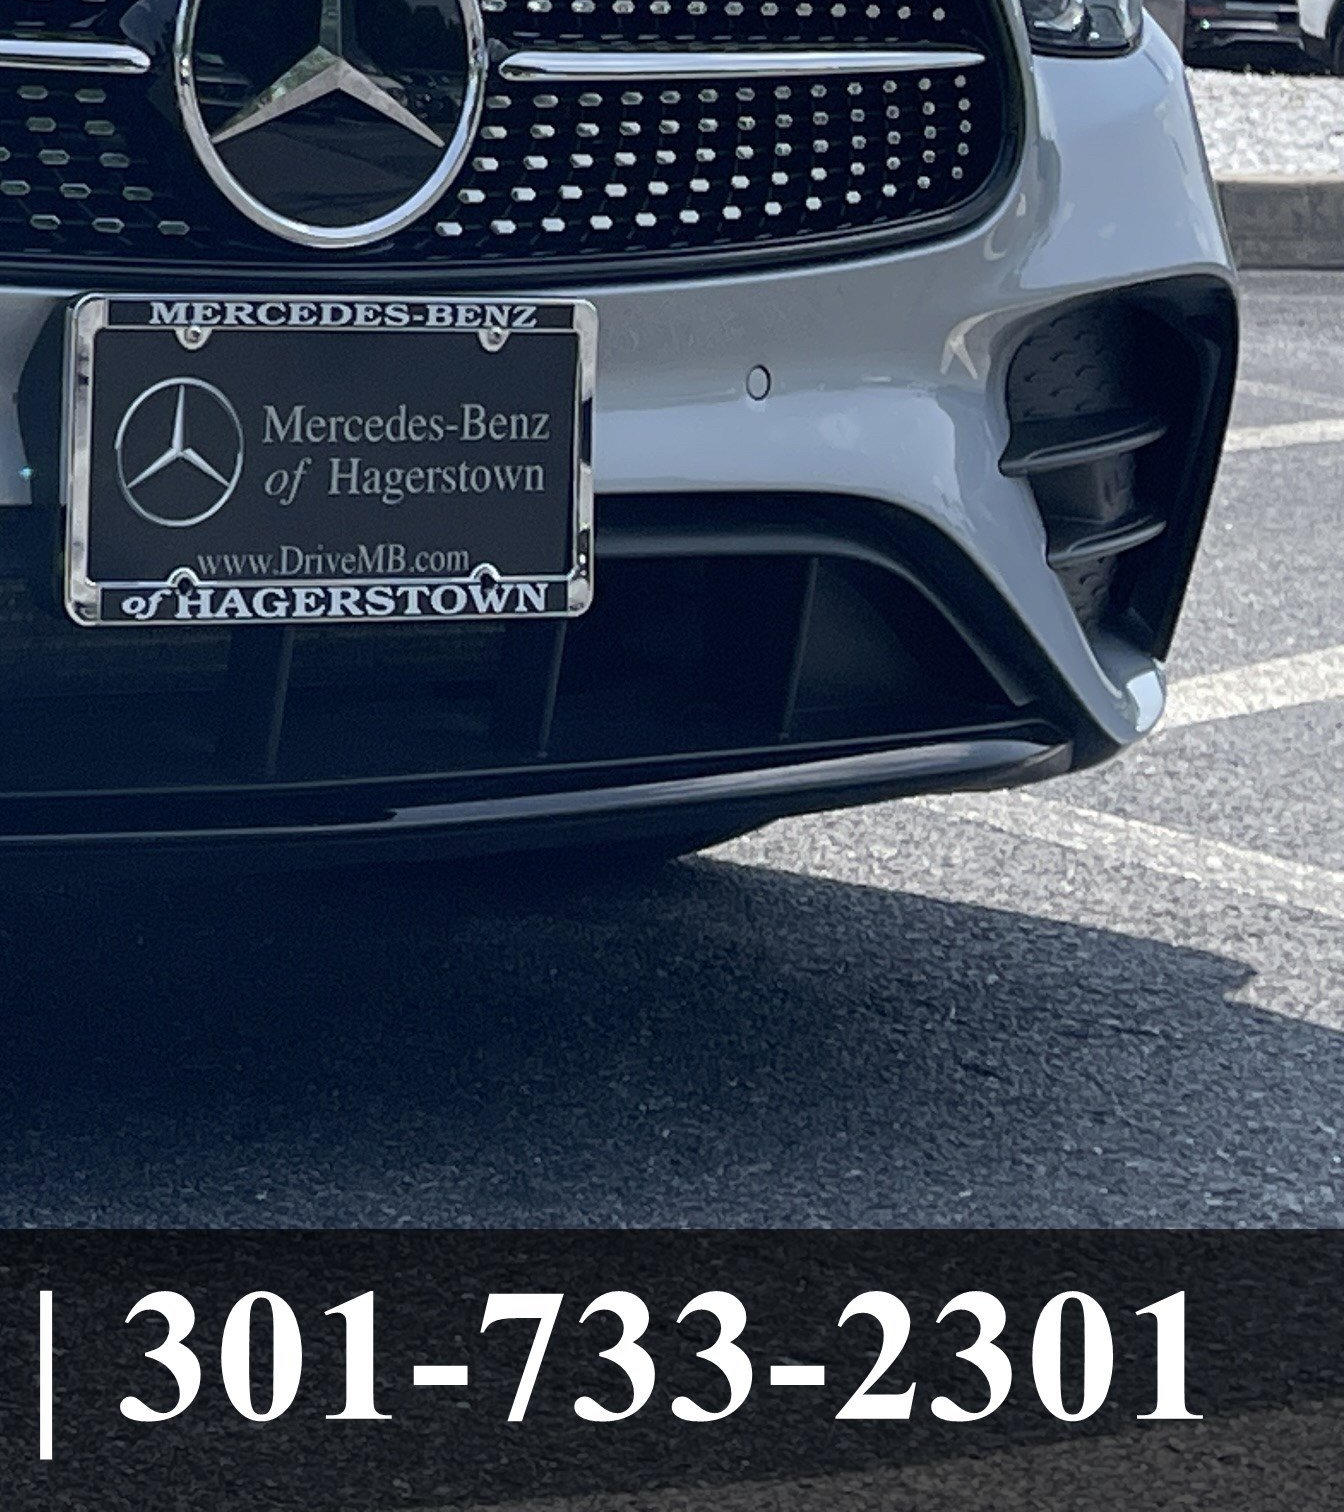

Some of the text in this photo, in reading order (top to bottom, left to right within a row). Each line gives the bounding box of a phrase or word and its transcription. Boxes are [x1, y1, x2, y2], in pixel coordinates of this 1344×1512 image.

[148, 302, 538, 328] MERCEDES-BENZ
[261, 403, 551, 445] Mercedes-Benz
[264, 457, 545, 505] of Hagerstown
[197, 544, 470, 576] www.DriveMB.com
[121, 582, 550, 620] of HAGERSTOWN
